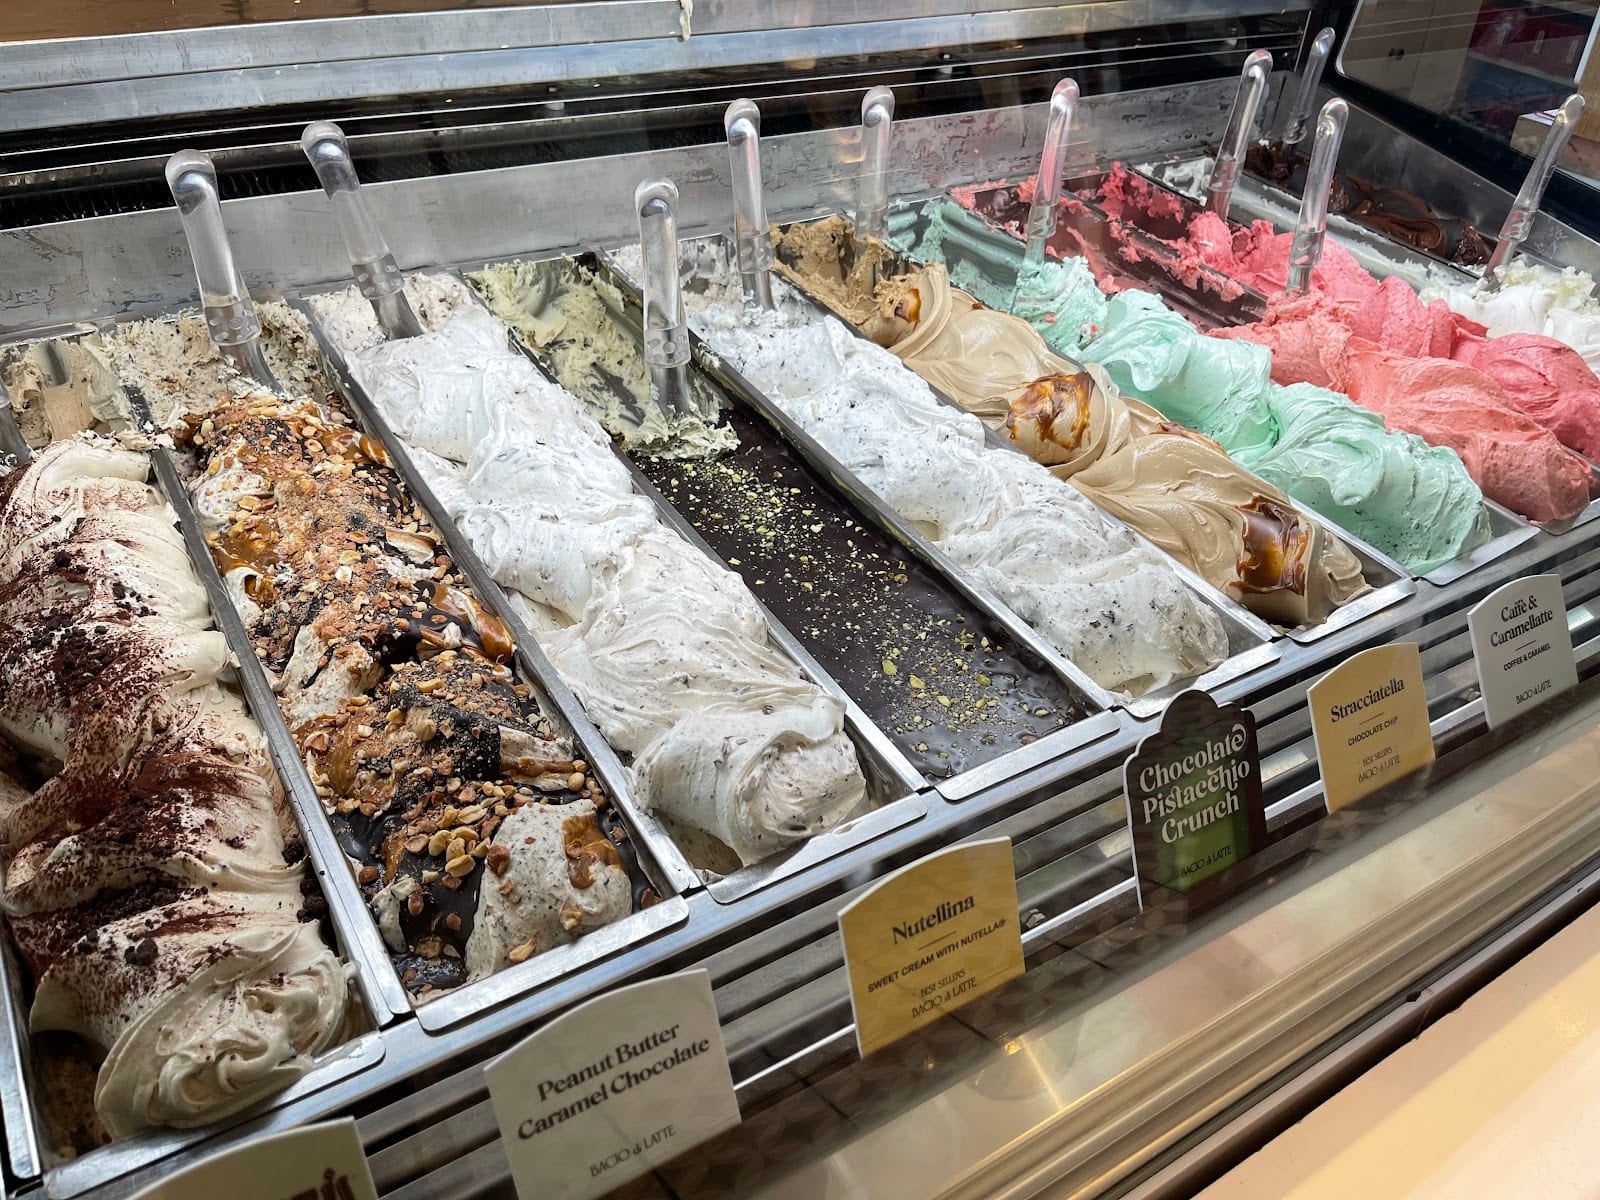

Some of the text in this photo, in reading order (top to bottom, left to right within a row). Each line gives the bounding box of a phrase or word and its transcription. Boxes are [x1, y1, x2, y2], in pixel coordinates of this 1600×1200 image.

[1528, 595, 1538, 610] &
[1490, 610, 1553, 647] Caramellatte
[1503, 656, 1523, 671] COFFEE
[1528, 643, 1551, 659] CARAMEL
[1331, 679, 1404, 723] Stracciatella
[1348, 716, 1398, 746] CHOCOLATE CHIP
[1140, 723, 1247, 793] Chocolate
[1142, 759, 1250, 824] Pistacchio
[1162, 792, 1240, 844] Crunch
[1213, 845, 1232, 862] LATTE
[892, 895, 975, 945] Nutellina
[868, 970, 900, 993] SWEET
[901, 954, 935, 977] CREAM
[936, 939, 960, 959] WITH
[920, 968, 966, 998] BEST SELLERS
[912, 995, 943, 1018] BACIO
[952, 977, 977, 998] LATTE
[537, 1024, 680, 1101] Peanut Butter
[518, 1038, 711, 1140] Caramel Chocolate
[590, 1149, 630, 1177] BACIO
[644, 1124, 676, 1149] LATTE
